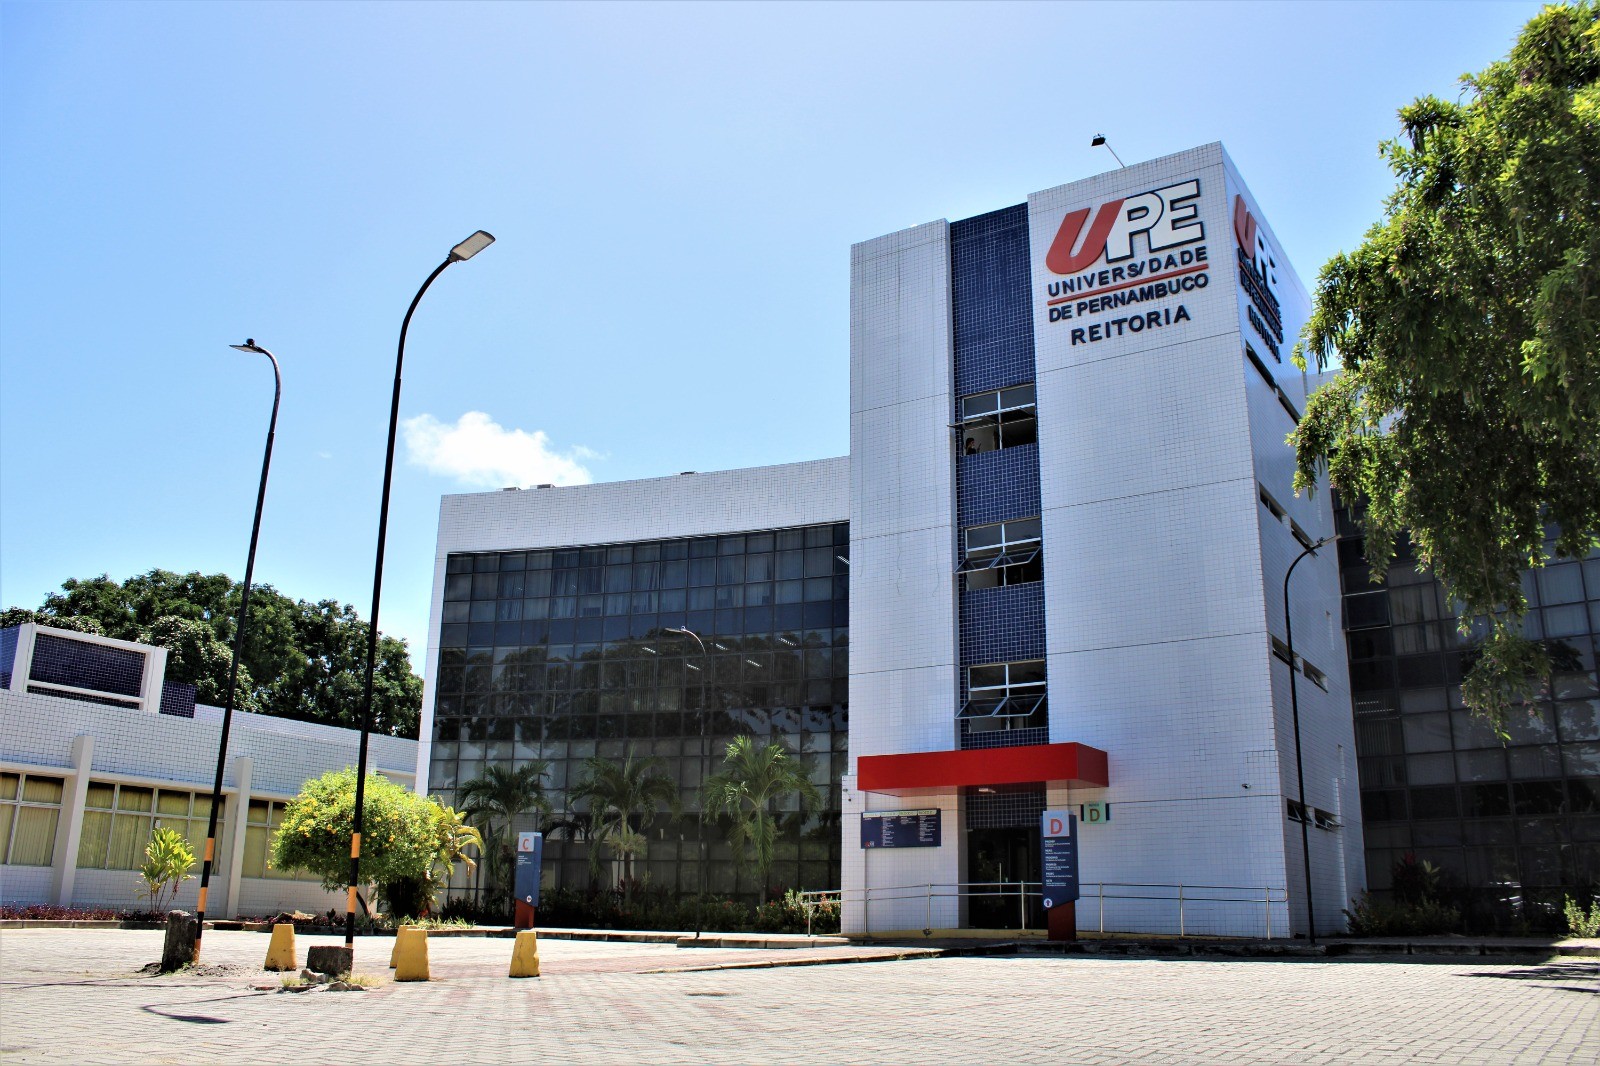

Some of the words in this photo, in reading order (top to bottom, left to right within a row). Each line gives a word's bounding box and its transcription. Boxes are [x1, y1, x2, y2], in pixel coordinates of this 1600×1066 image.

[1045, 178, 1205, 273] UPE
[1048, 246, 1208, 297] UNIVERSIDADE
[1049, 305, 1073, 322] DE
[1077, 273, 1209, 317] PERNAMBUCO
[1071, 305, 1191, 346] REITORIA
[1050, 818, 1063, 835] D
[1089, 808, 1100, 822] D
[522, 838, 530, 850] C
